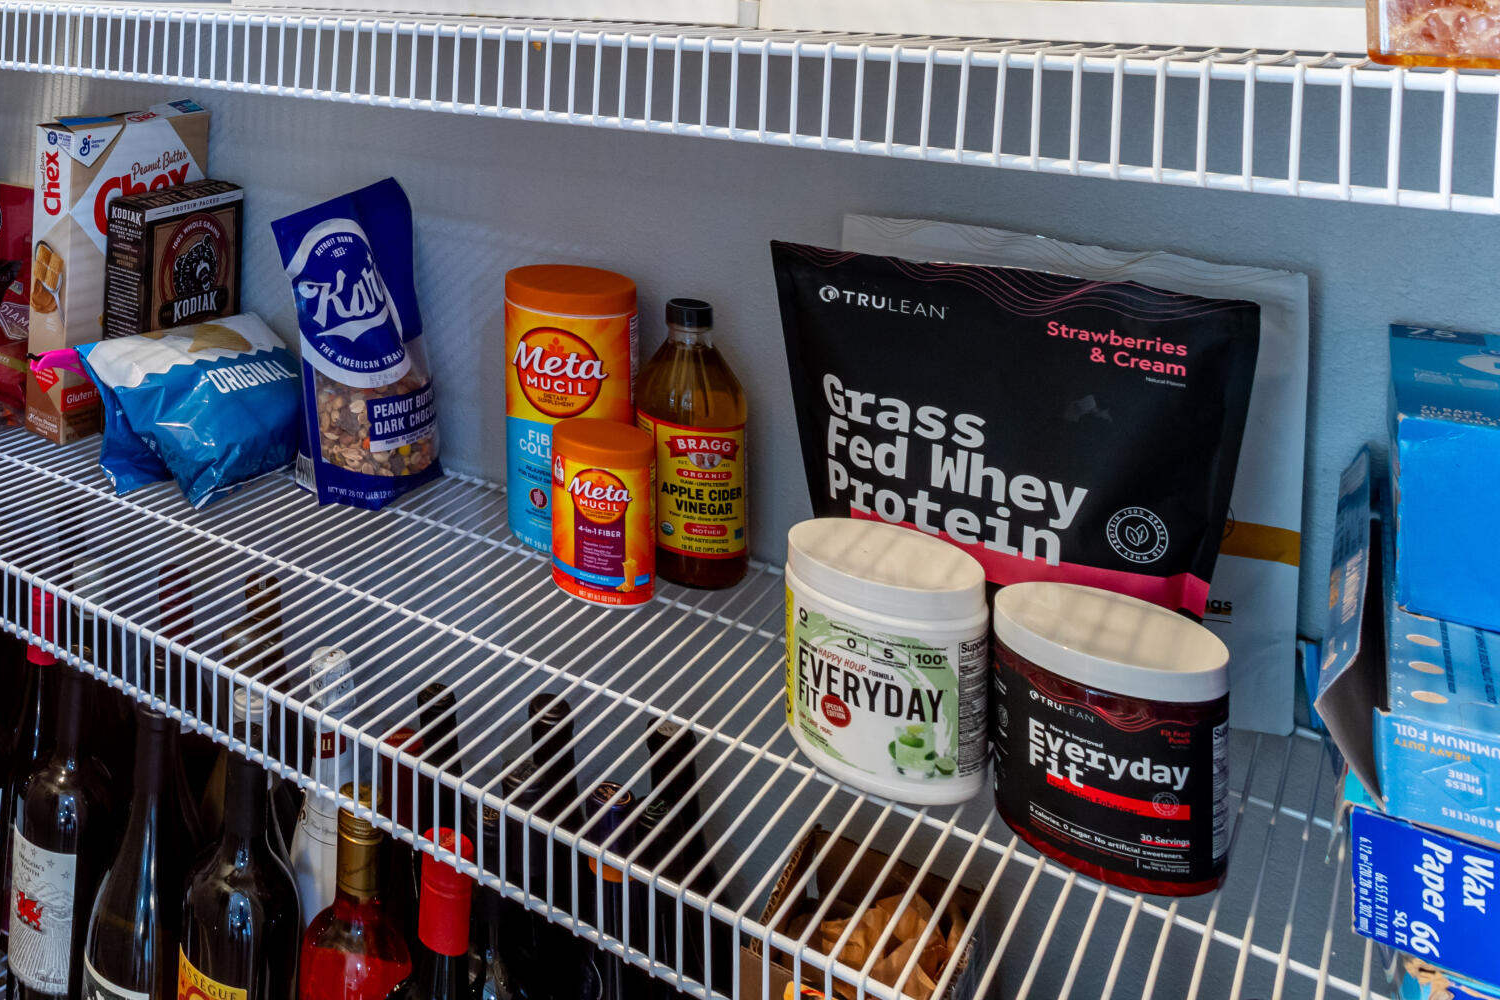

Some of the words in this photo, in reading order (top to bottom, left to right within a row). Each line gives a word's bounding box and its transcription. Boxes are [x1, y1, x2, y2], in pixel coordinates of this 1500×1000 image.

[131, 157, 162, 181] Peanut
[162, 149, 189, 171] Butter
[43, 150, 62, 218] Chex
[111, 206, 143, 227] KODIAK
[182, 220, 203, 234] WHOLE
[203, 220, 221, 240] GRAINS
[173, 290, 218, 323] KODIAK
[842, 289, 947, 321] TRULEAN
[1046, 319, 1189, 358] Strawberries
[318, 342, 334, 360] THE
[335, 353, 380, 370] AMERICAN
[512, 341, 609, 380] Meta
[1090, 345, 1107, 364] &
[1112, 350, 1188, 378] Cream
[207, 359, 299, 394] ORIGINAL
[526, 374, 588, 396] MUCIL
[66, 390, 93, 404] Gluten
[373, 397, 414, 419] PEANUT
[822, 372, 988, 449] Grass
[374, 416, 406, 436] DARK
[676, 438, 731, 453] BRAGG
[682, 470, 727, 479] ORGANIC
[826, 415, 910, 481] Fed
[930, 448, 1089, 531] Whey
[567, 476, 633, 502] Meta
[661, 481, 705, 501] APPLE
[708, 486, 743, 502] CIDER
[579, 499, 620, 512] MUCIL
[675, 498, 734, 516] VINEGAR
[827, 454, 1063, 568] Protein
[598, 528, 622, 539] FIBER
[817, 647, 843, 666] HAPPY
[843, 659, 867, 673] HOUR
[883, 648, 895, 660] 5
[915, 653, 949, 666] 100%
[799, 645, 943, 723] EVERYDAY
[868, 669, 895, 681] FORMULA
[799, 679, 820, 712] FIT
[824, 702, 845, 714] SPECIAL
[826, 710, 846, 721] EDITION
[1041, 694, 1095, 724] TRULEAN
[1049, 723, 1063, 736] New
[1071, 733, 1105, 750] Improved
[1160, 729, 1172, 738] Fit
[1171, 730, 1191, 741] Fruit
[1168, 736, 1191, 745] Punch
[1390, 721, 1428, 742] FOIL
[1028, 716, 1191, 791] Everyday
[1392, 736, 1426, 753] DUTY
[1429, 745, 1471, 763] HEAVY
[1028, 740, 1085, 789] Fit
[1444, 777, 1484, 797] PRESS
[1447, 768, 1480, 786] HERE
[1441, 806, 1494, 829] GROCERS
[1034, 807, 1062, 828] calories.
[1070, 826, 1094, 842] sugar.
[1094, 835, 1107, 846] No
[1107, 840, 1142, 855] artificial
[1142, 848, 1185, 861] sweeteners.
[1140, 832, 1153, 842] 30
[1154, 836, 1191, 848] Servings
[1411, 837, 1453, 922] Paper
[1461, 852, 1495, 915] Wax
[1409, 919, 1441, 959] 66
